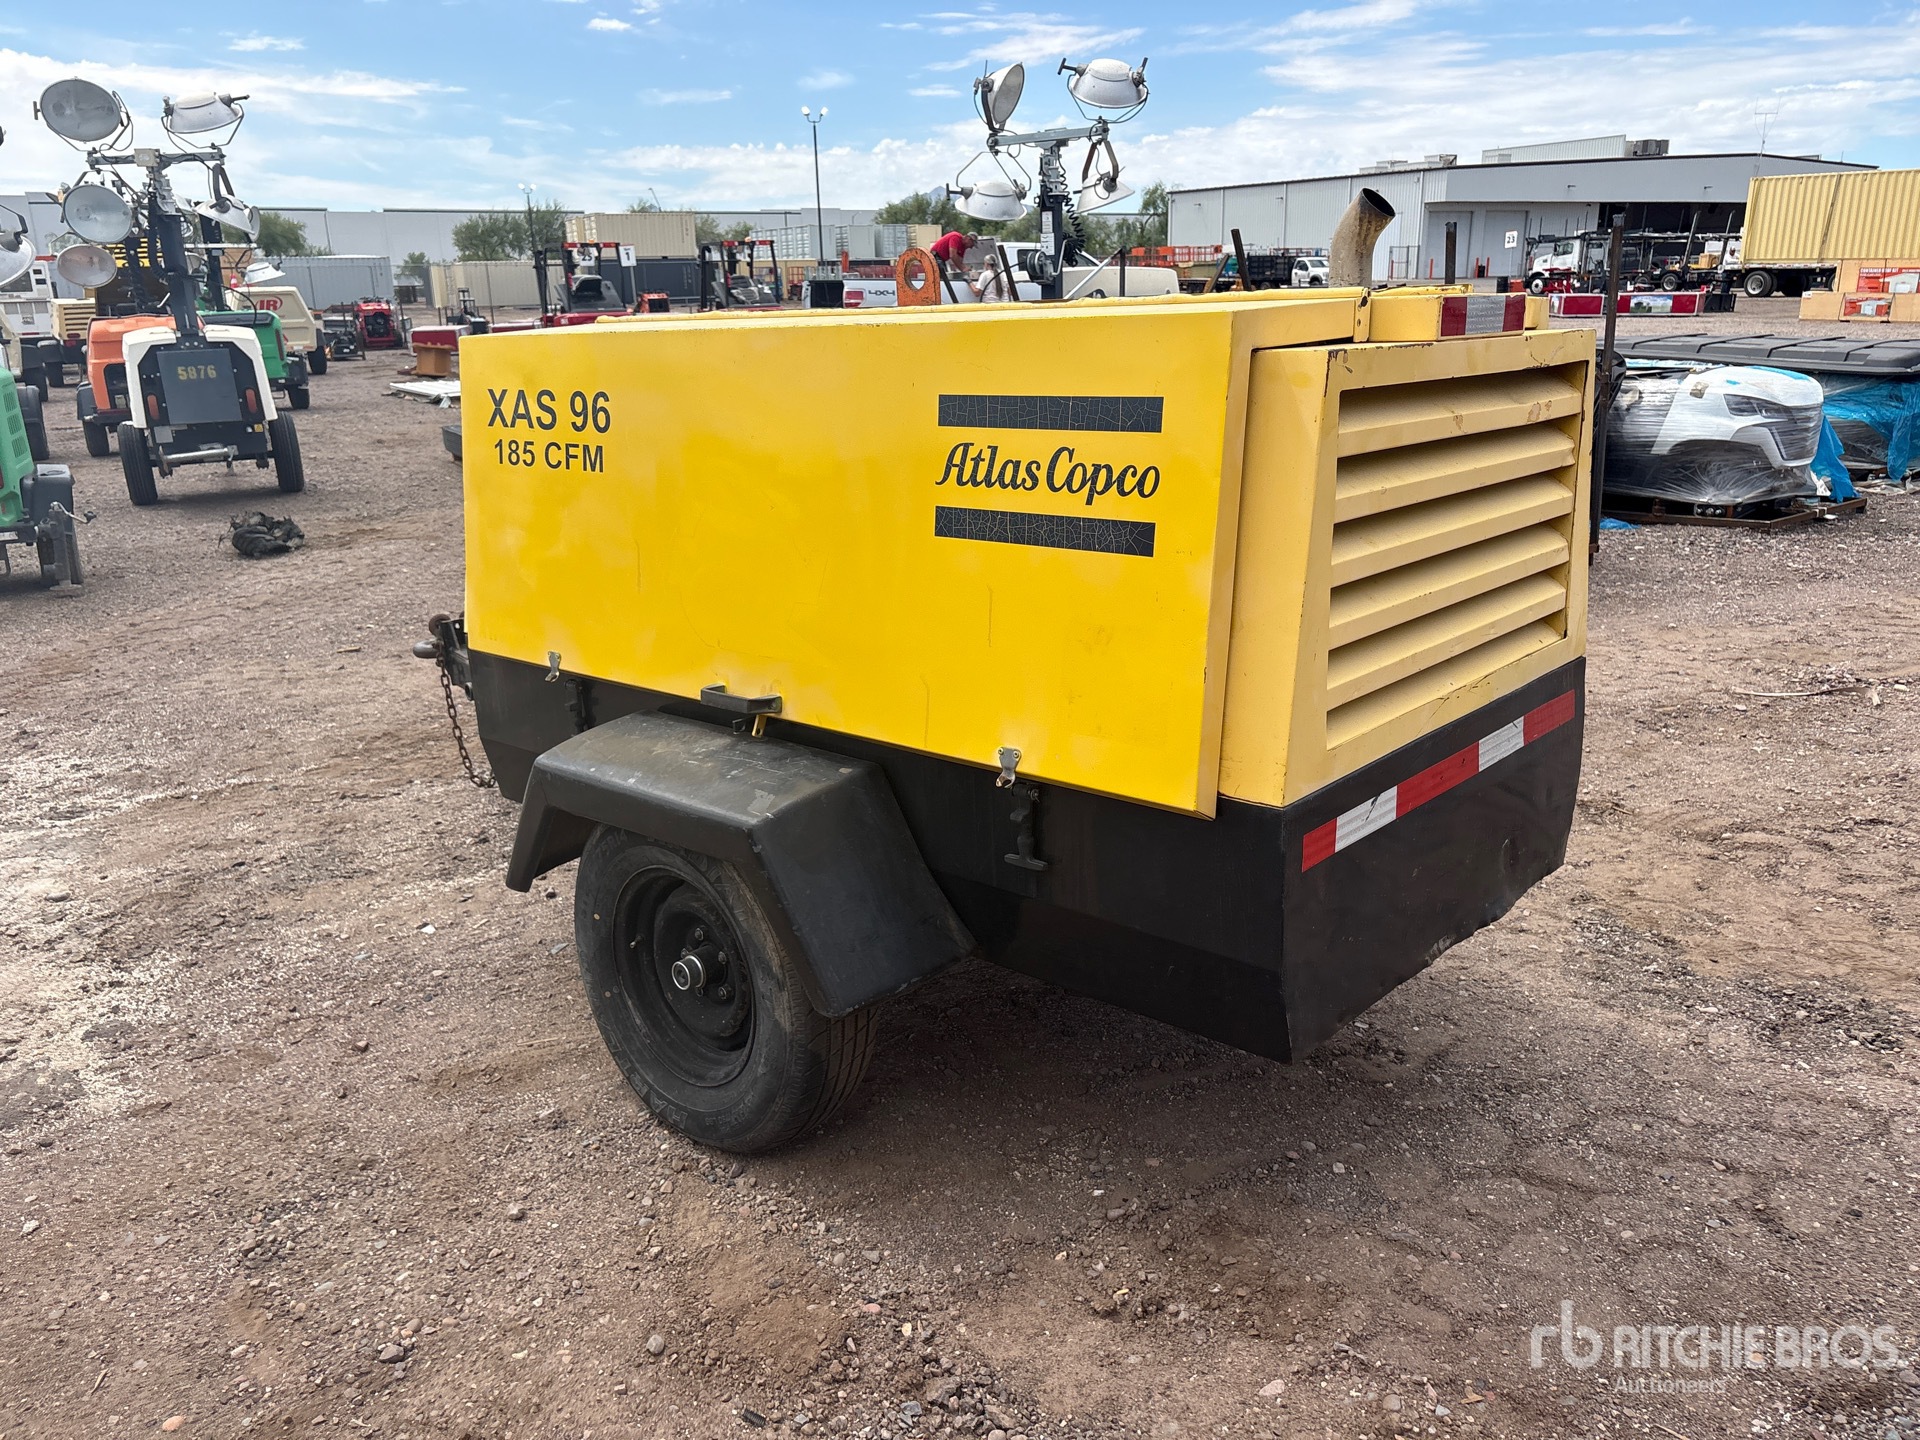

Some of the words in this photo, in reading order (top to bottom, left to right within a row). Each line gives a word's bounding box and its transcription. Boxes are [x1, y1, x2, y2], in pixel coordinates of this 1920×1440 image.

[1507, 235, 1515, 244] 23
[625, 252, 631, 261] 1
[259, 299, 279, 311] IR
[177, 364, 217, 380] 5876
[488, 388, 557, 430] XAS
[569, 390, 611, 434] 96
[494, 438, 536, 468] 185
[544, 441, 604, 473] CFM
[935, 442, 1041, 491] Atlas
[1046, 446, 1160, 506] Copco
